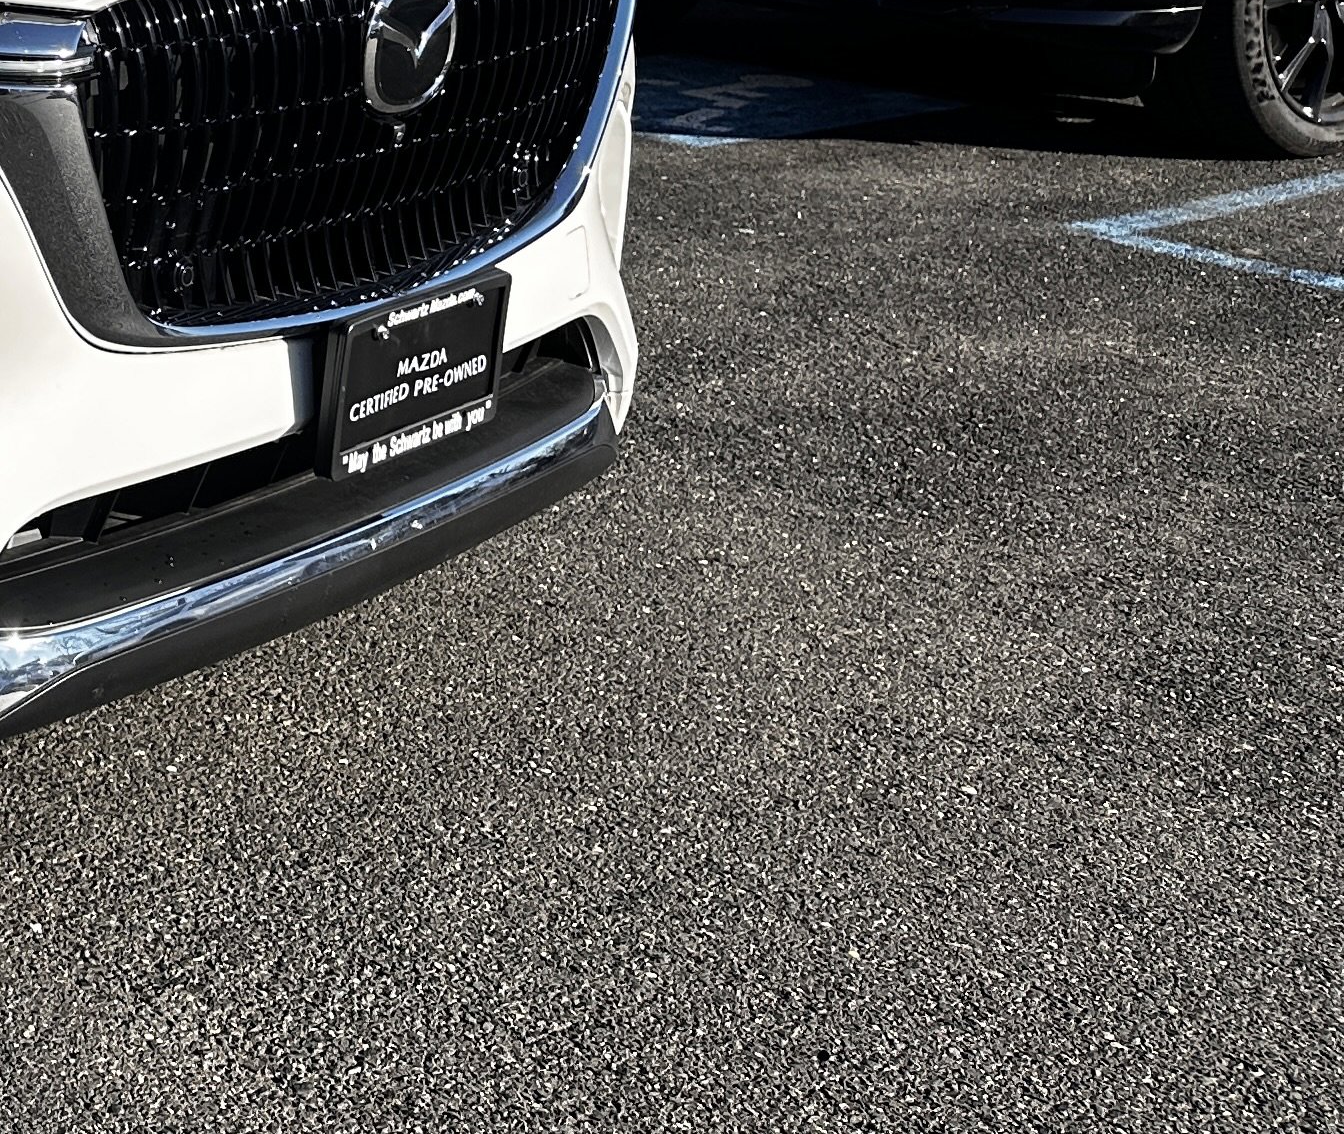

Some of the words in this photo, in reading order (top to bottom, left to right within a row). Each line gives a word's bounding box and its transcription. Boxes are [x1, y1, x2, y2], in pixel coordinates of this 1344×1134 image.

[396, 348, 448, 377] MAZDA
[349, 382, 410, 422] CERTIFIED
[413, 354, 487, 397] PRE-OWNED
[372, 442, 387, 464] the
[432, 420, 444, 440] be
